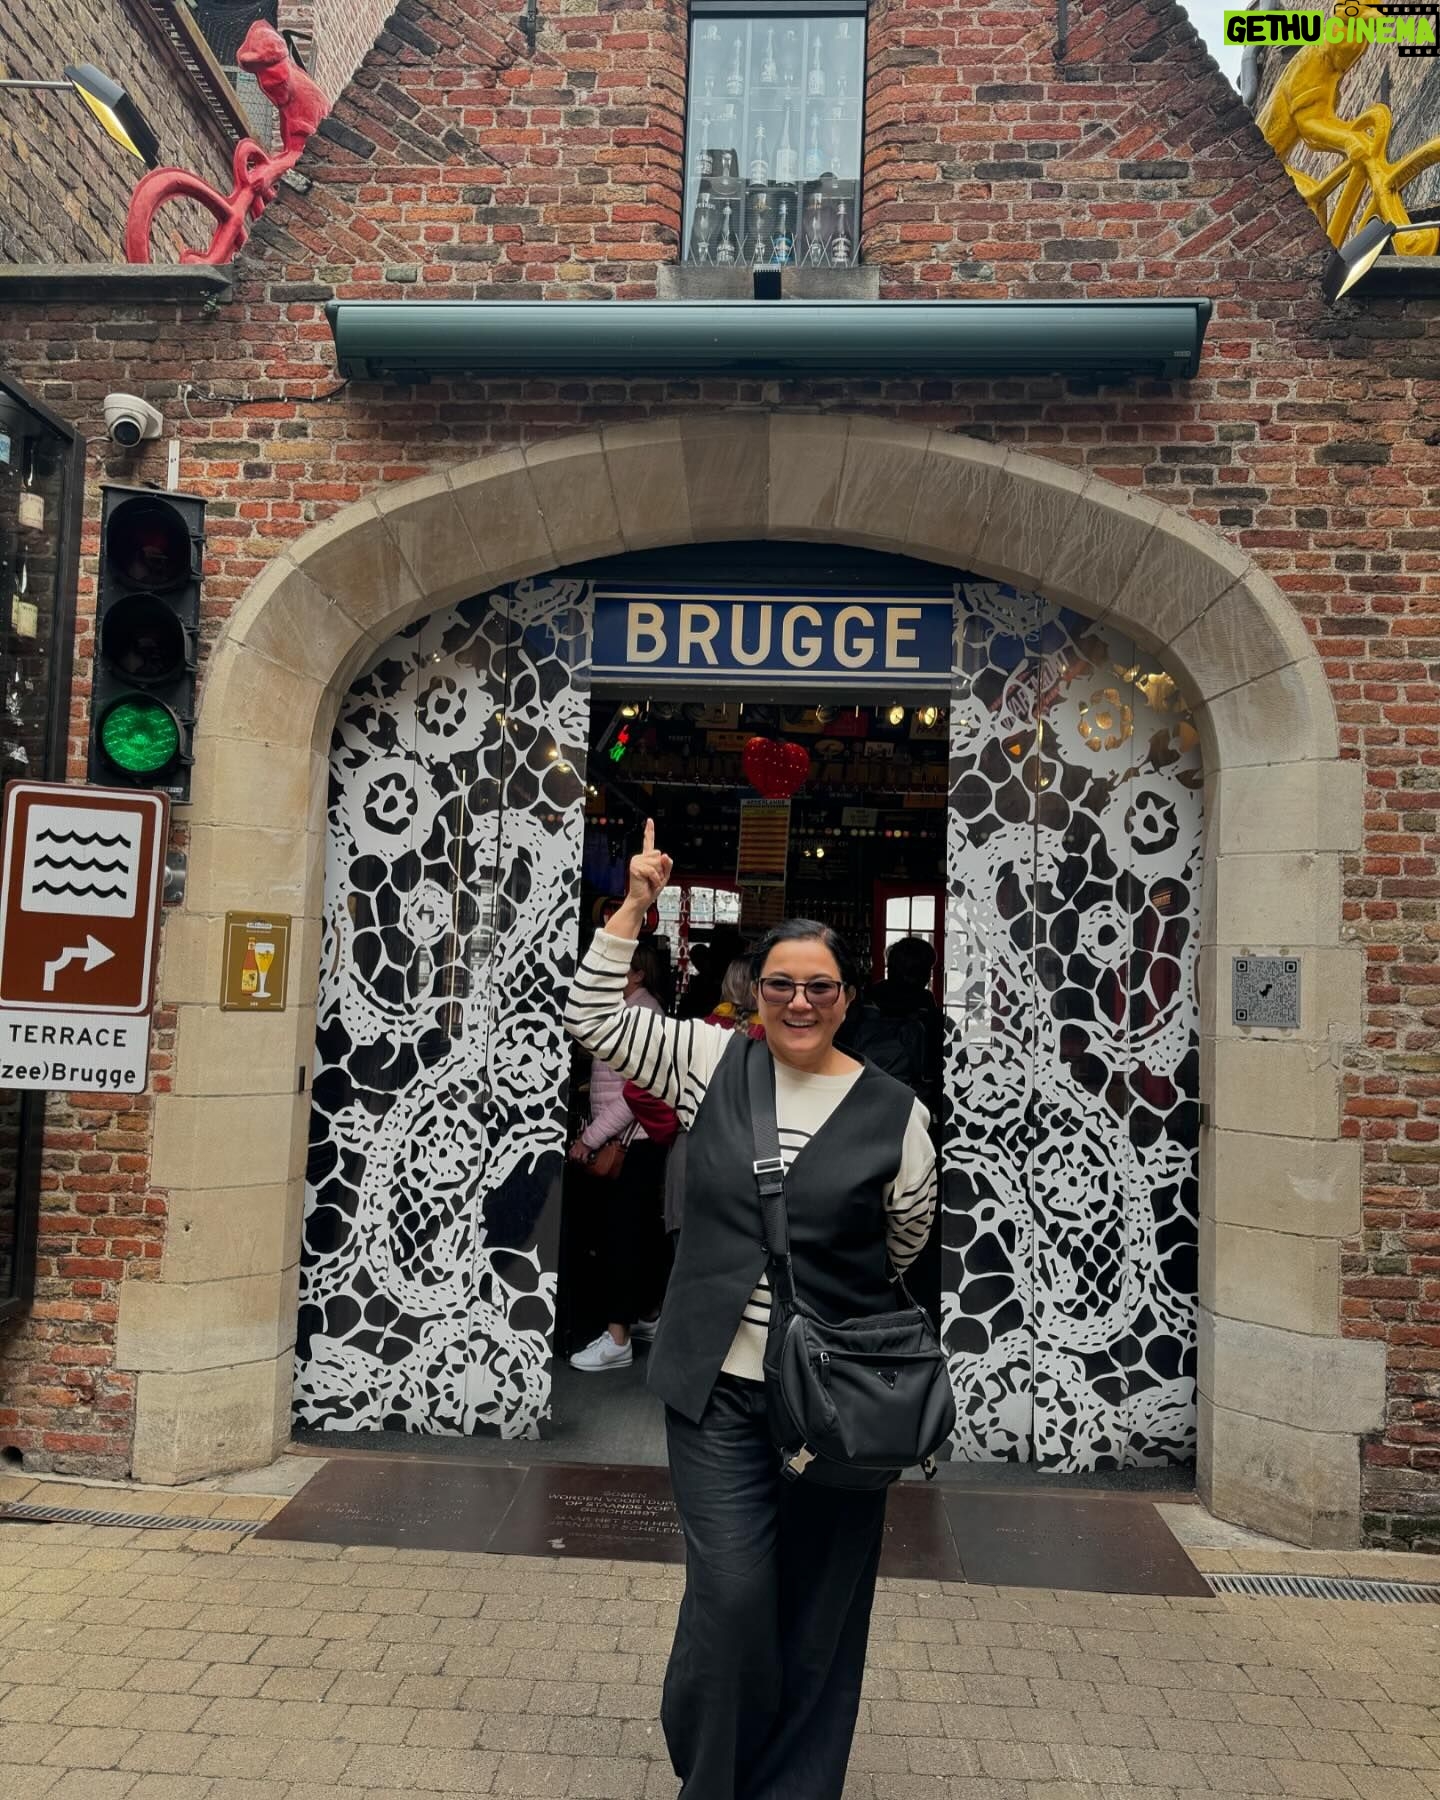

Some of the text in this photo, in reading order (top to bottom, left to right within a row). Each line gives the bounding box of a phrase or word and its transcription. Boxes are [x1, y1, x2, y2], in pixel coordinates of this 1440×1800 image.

[626, 602, 923, 669] BRUGGE
[9, 1024, 127, 1047] TERRACE
[0, 1060, 136, 1089] zee)Brugge
